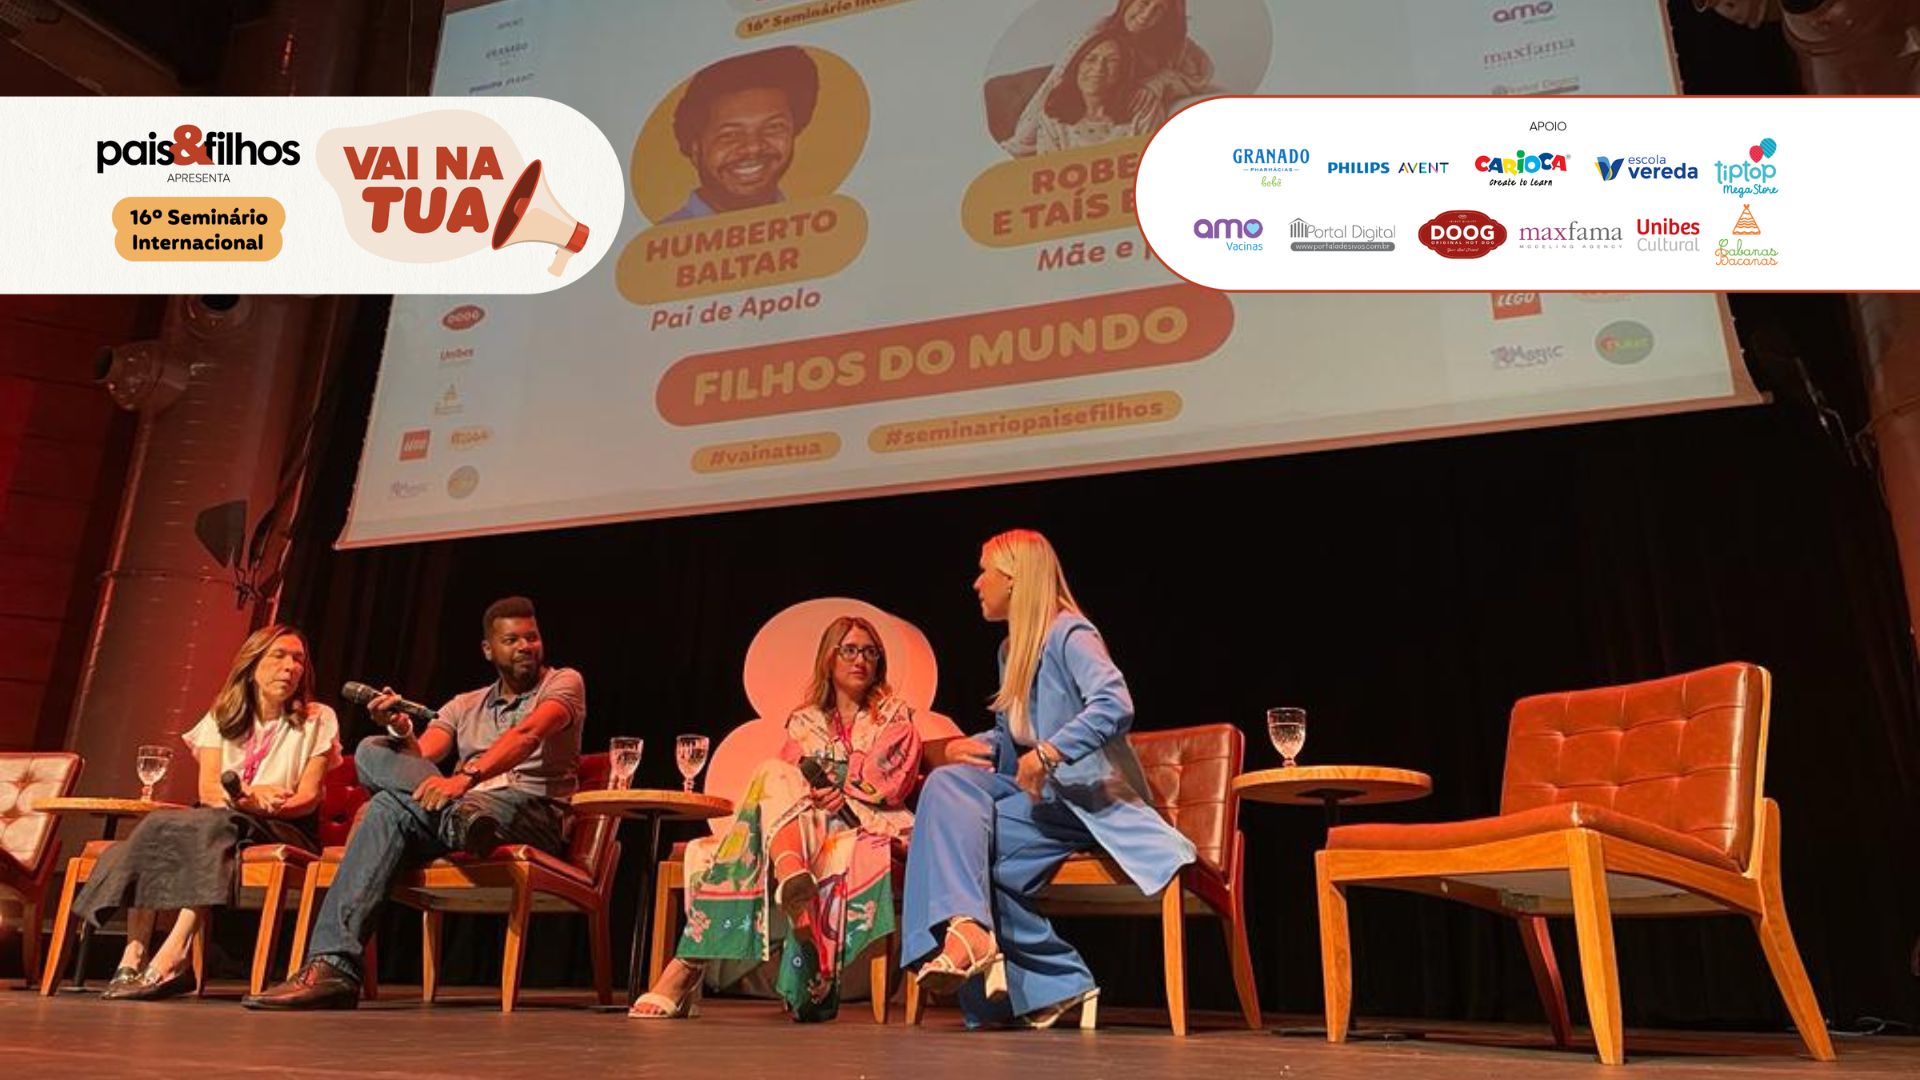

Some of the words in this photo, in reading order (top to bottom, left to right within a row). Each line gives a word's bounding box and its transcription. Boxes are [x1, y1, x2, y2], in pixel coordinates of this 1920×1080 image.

[993, 209, 1013, 235] E
[1021, 187, 1110, 229] TAÍS
[645, 209, 838, 262] HUMBERTO
[1036, 241, 1106, 272] Mãe
[1115, 241, 1133, 258] e
[675, 247, 799, 288] BALTAR
[650, 305, 695, 332] Pai
[700, 301, 733, 324] de
[739, 287, 821, 320] Apolo
[693, 350, 866, 407] FILHOS
[878, 339, 955, 382] DO
[968, 306, 1188, 369] MUNDO
[884, 400, 1164, 447] #seminariopaisefilhos
[709, 440, 822, 467] #vainatua
